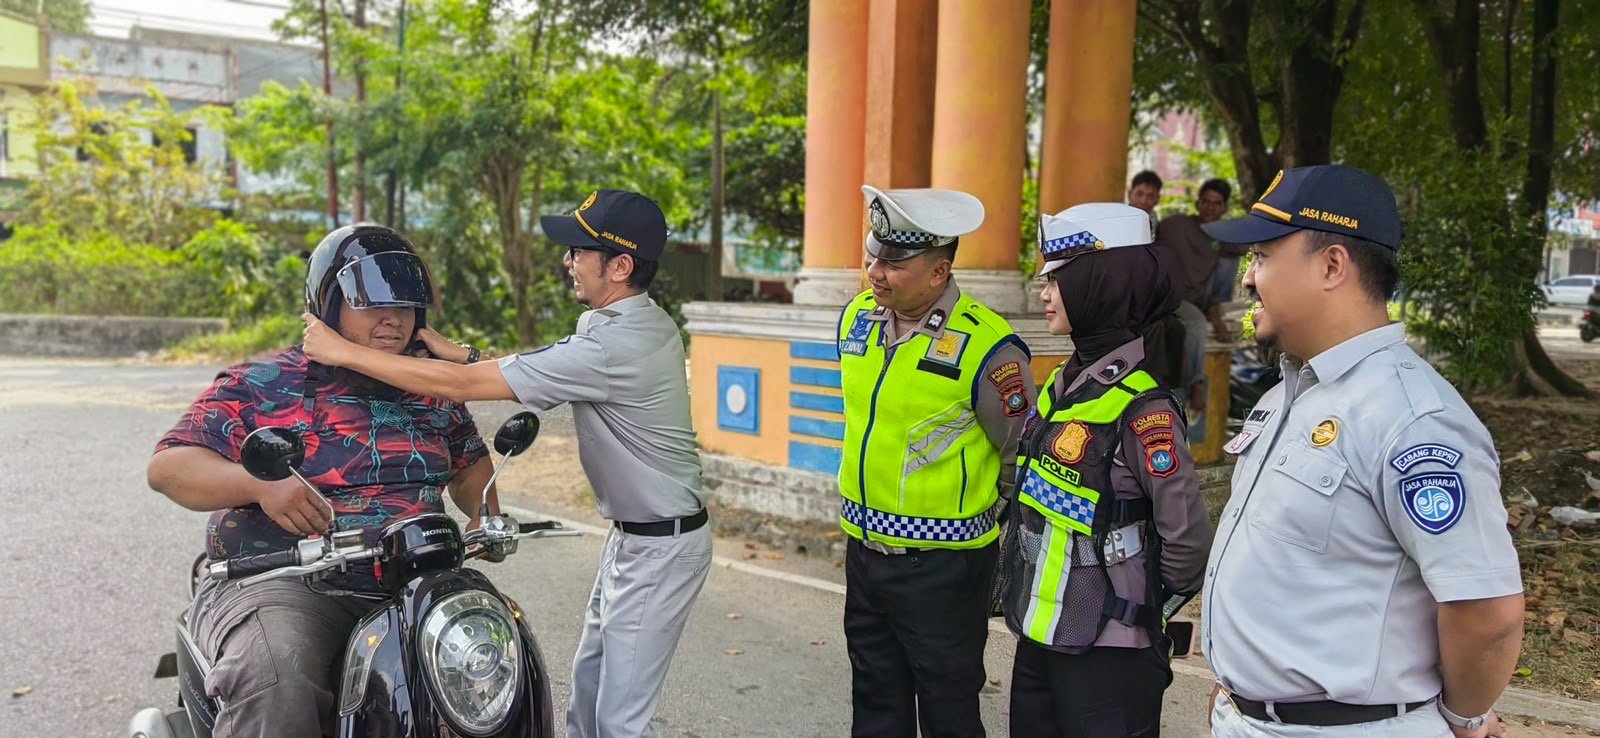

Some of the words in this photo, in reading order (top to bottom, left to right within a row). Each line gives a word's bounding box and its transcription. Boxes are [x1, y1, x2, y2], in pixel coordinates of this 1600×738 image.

[1299, 207, 1320, 220] JASA
[1320, 211, 1358, 229] RAHARJA
[601, 231, 614, 241] JASA
[991, 362, 1018, 379] POLRESTA
[1132, 414, 1169, 428] POLRESTA
[1398, 449, 1429, 467] CABANG
[1432, 448, 1455, 462] KEPRI
[1043, 457, 1078, 483] POLRI
[1405, 481, 1422, 492] JASA
[1422, 479, 1456, 489] RAHARJA
[422, 528, 453, 537] HONDA
